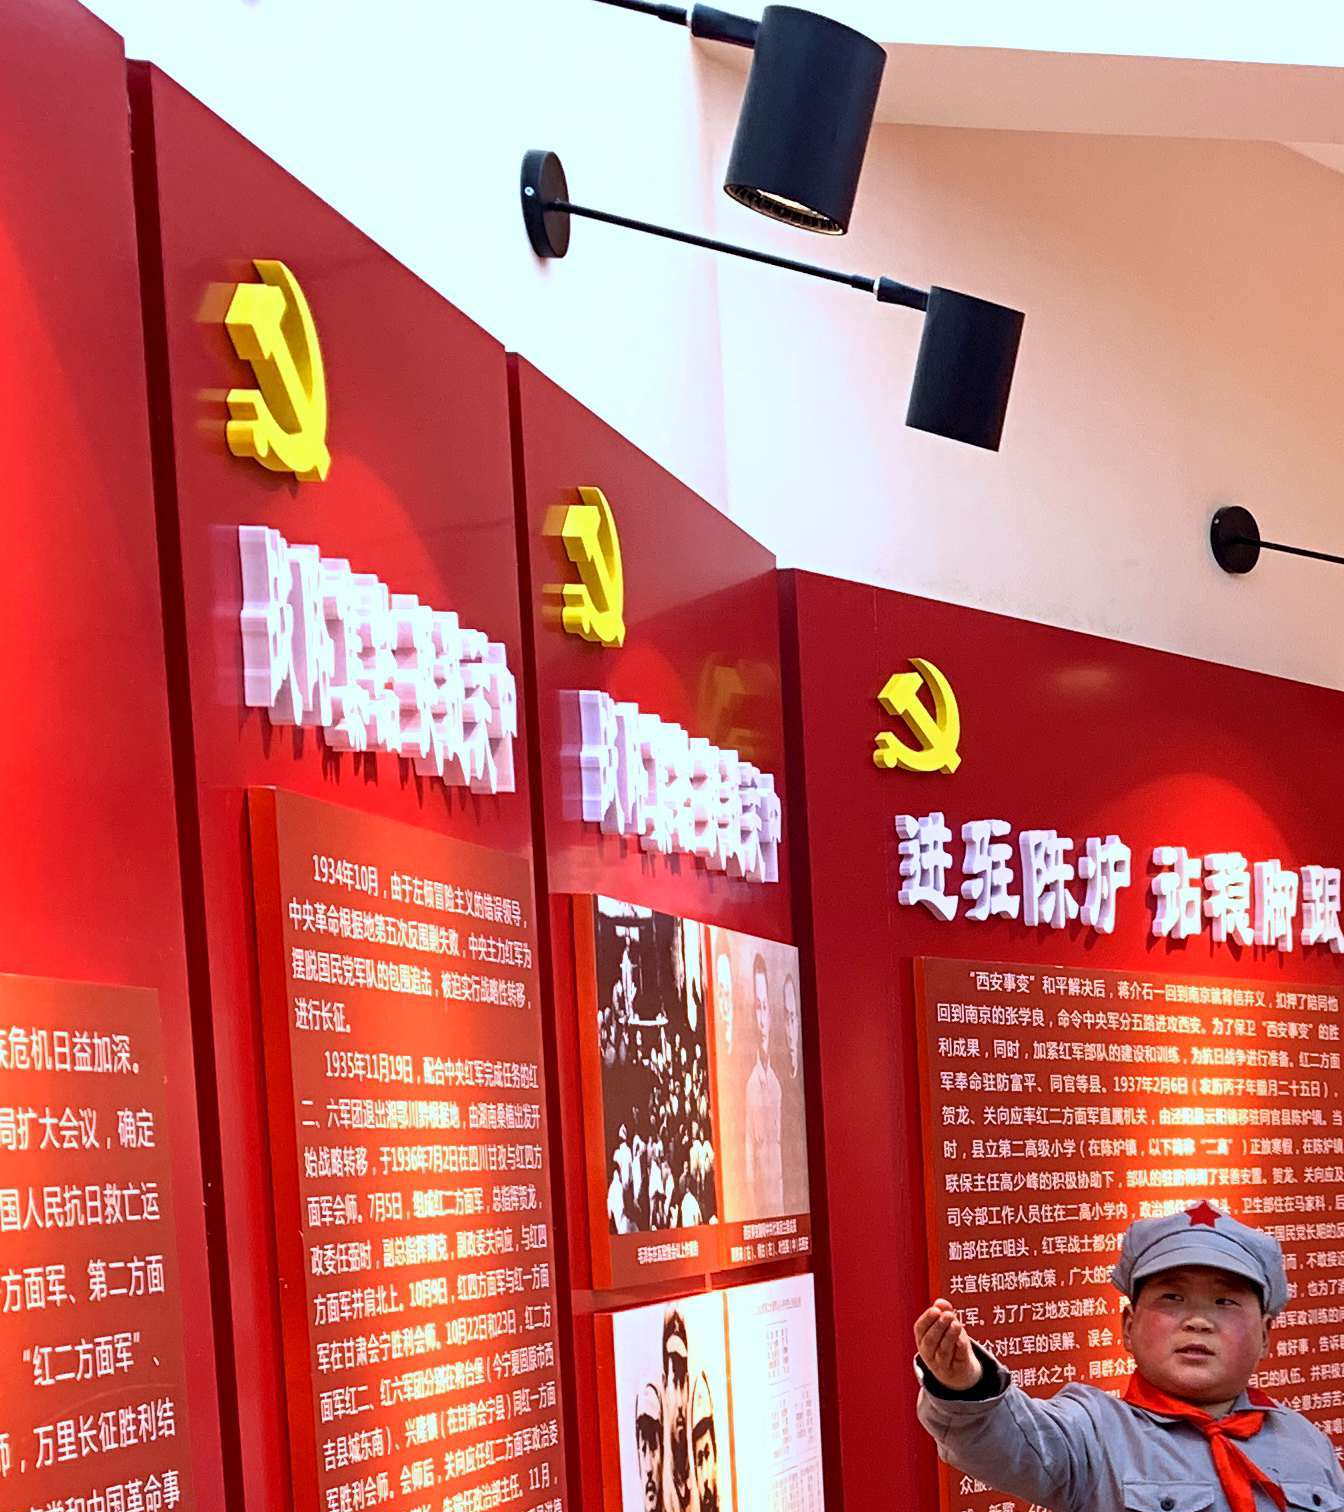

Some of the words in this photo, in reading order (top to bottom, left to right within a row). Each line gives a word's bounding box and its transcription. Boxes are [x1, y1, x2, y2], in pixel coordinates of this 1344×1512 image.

[896, 812, 1131, 934] 进驻陈炉
[0, 1255, 165, 1312] 方面军、第二方面
